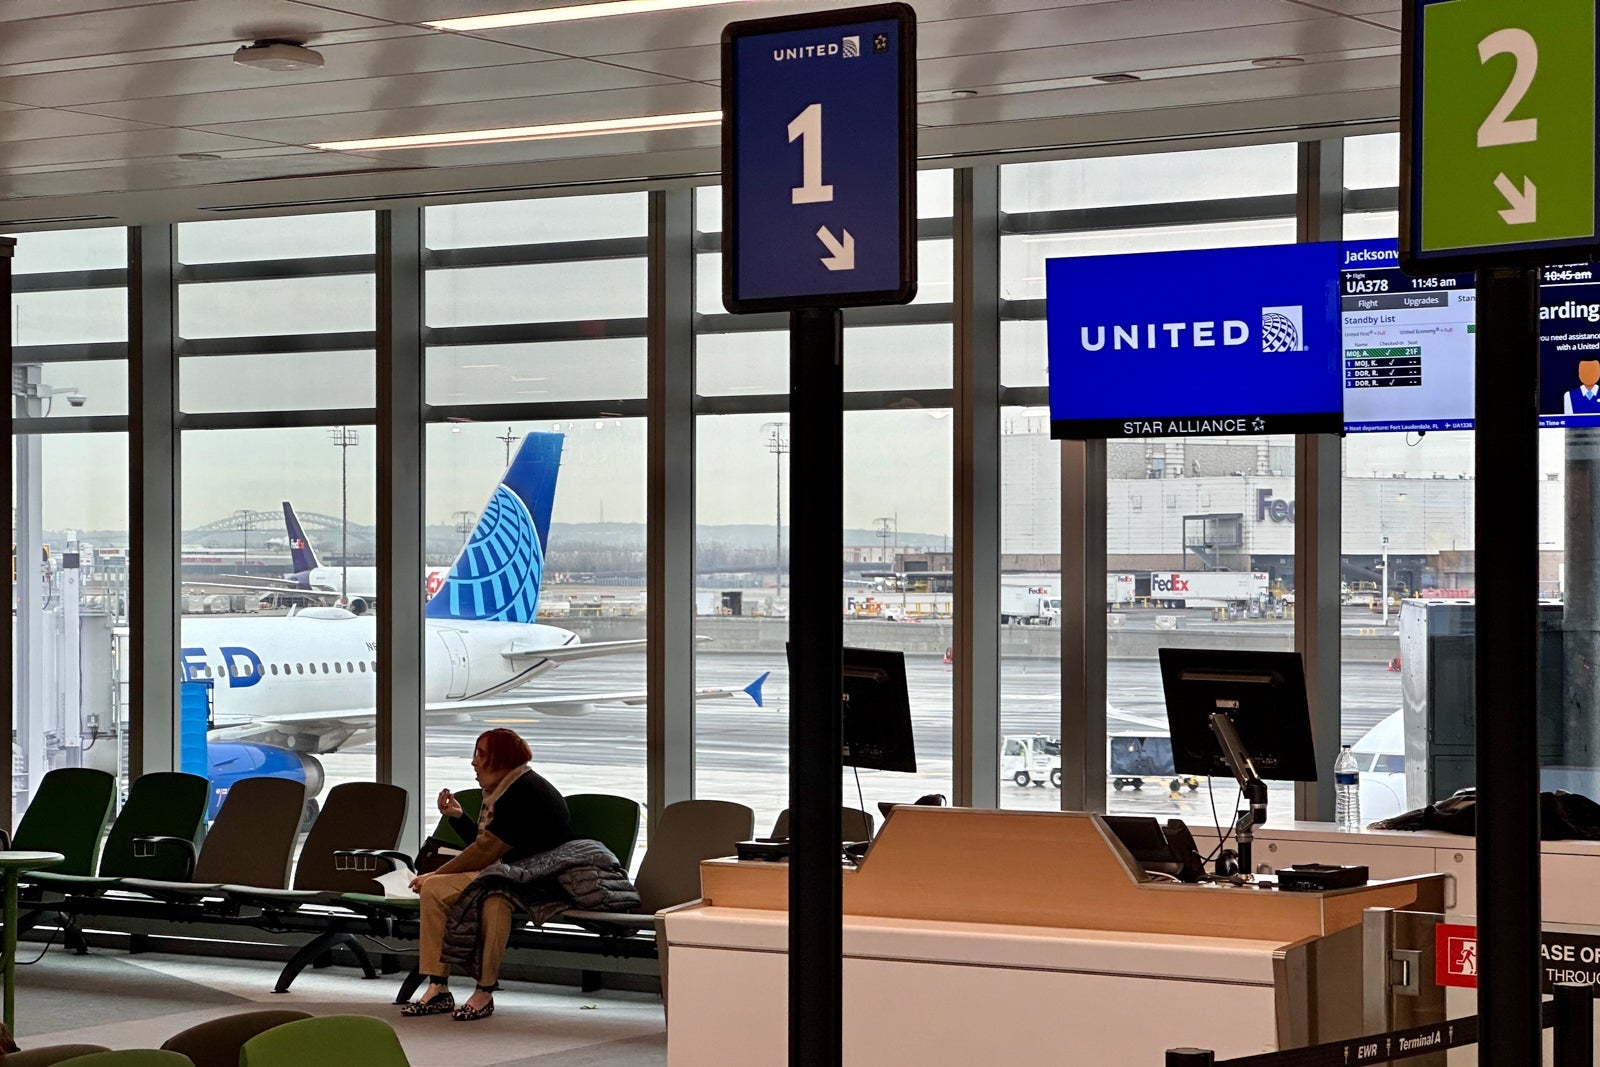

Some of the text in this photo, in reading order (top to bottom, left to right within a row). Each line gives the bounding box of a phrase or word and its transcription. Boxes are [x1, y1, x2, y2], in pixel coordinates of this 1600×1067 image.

[773, 43, 839, 61] UNITED
[1477, 27, 1538, 148] 2
[787, 103, 834, 205] 1
[1411, 277, 1456, 288] 11:45 am
[1574, 271, 1592, 280] am
[1346, 279, 1389, 293] UA378
[1358, 296, 1439, 309] Flight Upgrades
[1540, 301, 1600, 322] arding
[1344, 315, 1396, 325] Standby List
[1080, 320, 1250, 351] UNITED
[1551, 333, 1567, 341] need
[1123, 419, 1247, 434] STAR ALLIANCE
[1382, 536, 1389, 544] 21
[1117, 575, 1133, 583] FedEx
[1152, 573, 1189, 592] FedEx
[1028, 587, 1048, 595] FedEx
[181, 647, 263, 688] ED
[1357, 1030, 1441, 1060] EWR Terminal A
